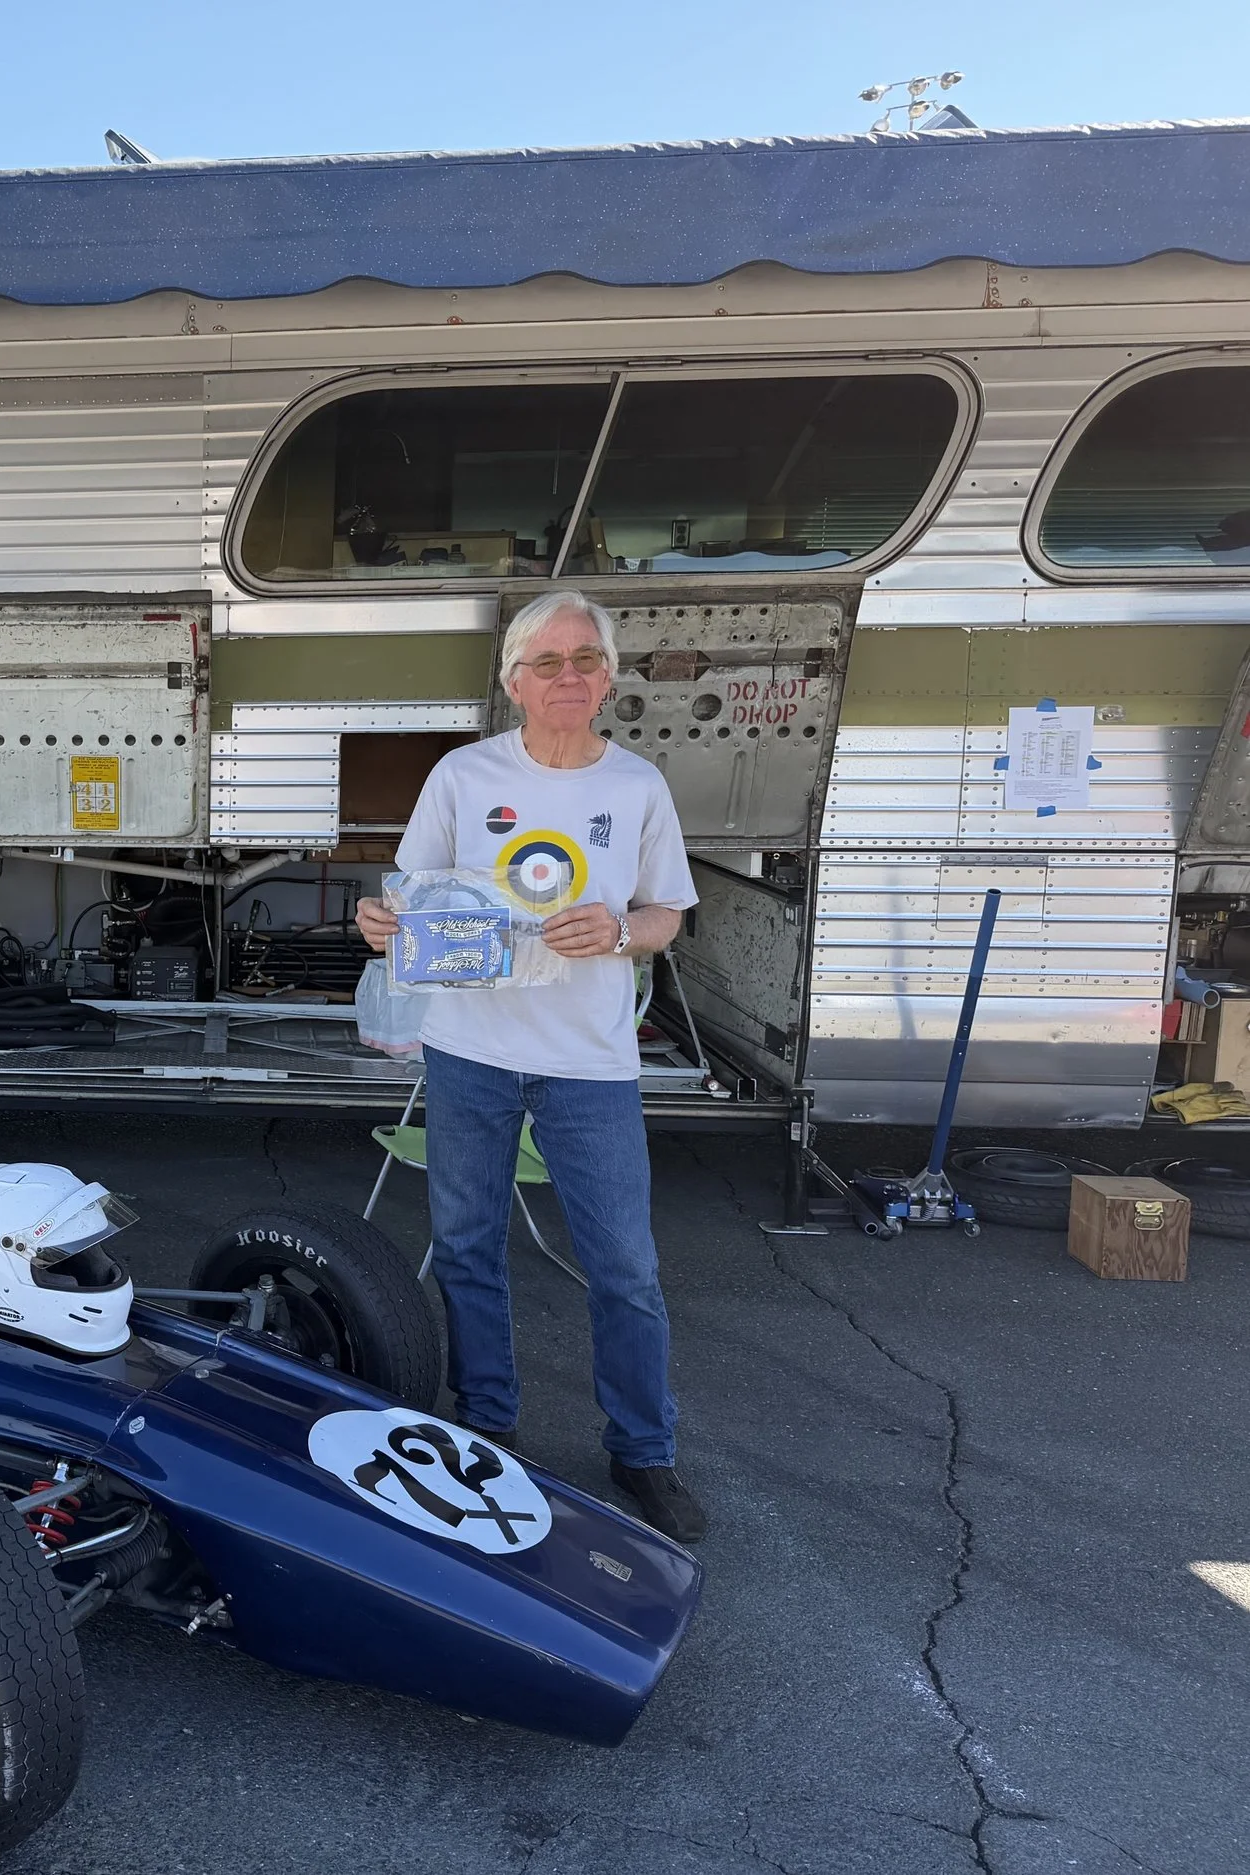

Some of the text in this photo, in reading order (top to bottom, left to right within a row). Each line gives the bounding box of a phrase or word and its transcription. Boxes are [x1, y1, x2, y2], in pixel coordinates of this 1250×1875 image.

[727, 678, 810, 701] DO NOT
[589, 838, 610, 849] TITAN
[458, 917, 492, 930] School
[34, 1222, 51, 1236] BELL
[236, 1228, 327, 1268] Hoosier
[353, 1422, 504, 1529] 72
[465, 1494, 537, 1546] X
